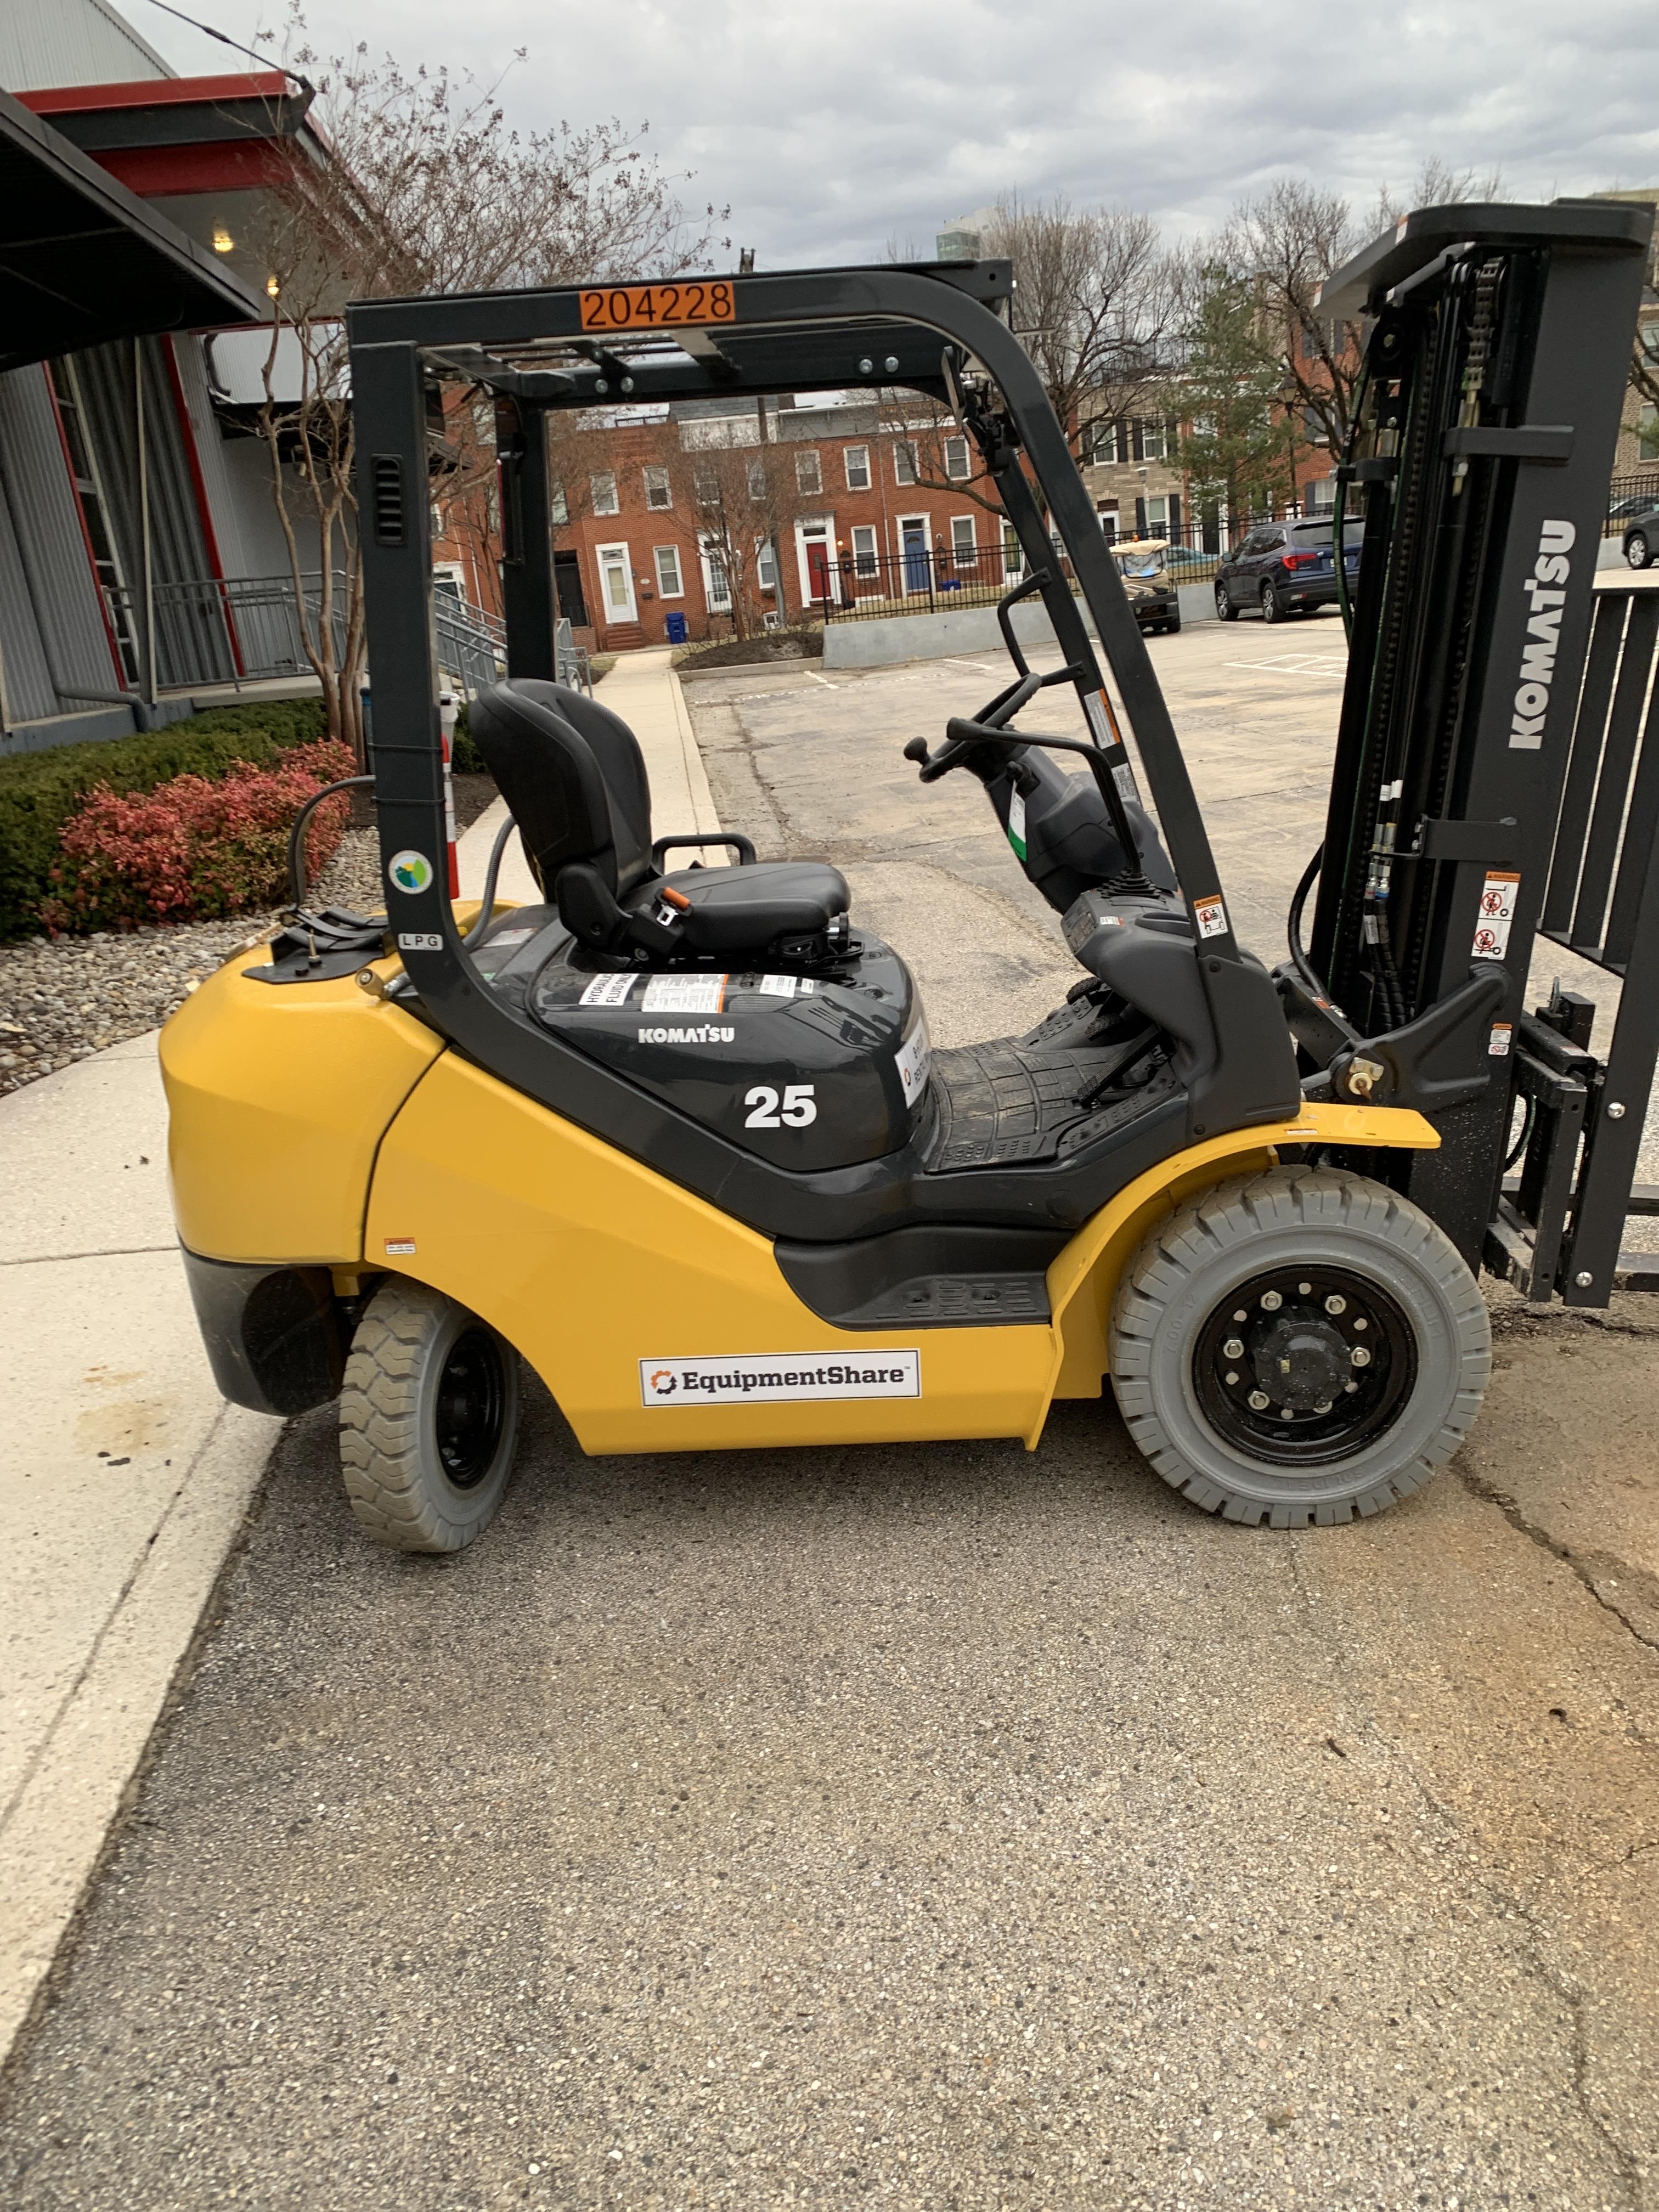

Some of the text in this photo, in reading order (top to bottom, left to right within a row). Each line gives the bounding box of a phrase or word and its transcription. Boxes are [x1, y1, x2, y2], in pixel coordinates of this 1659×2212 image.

[584, 283, 732, 326] 204228
[1509, 519, 1576, 750] KOMATSU
[402, 935, 438, 946] LPG
[606, 985, 623, 1002] FLUID
[638, 1024, 735, 1043] KOMATSU
[744, 1085, 817, 1128] 25
[682, 1366, 905, 1393] EquipmentShare
